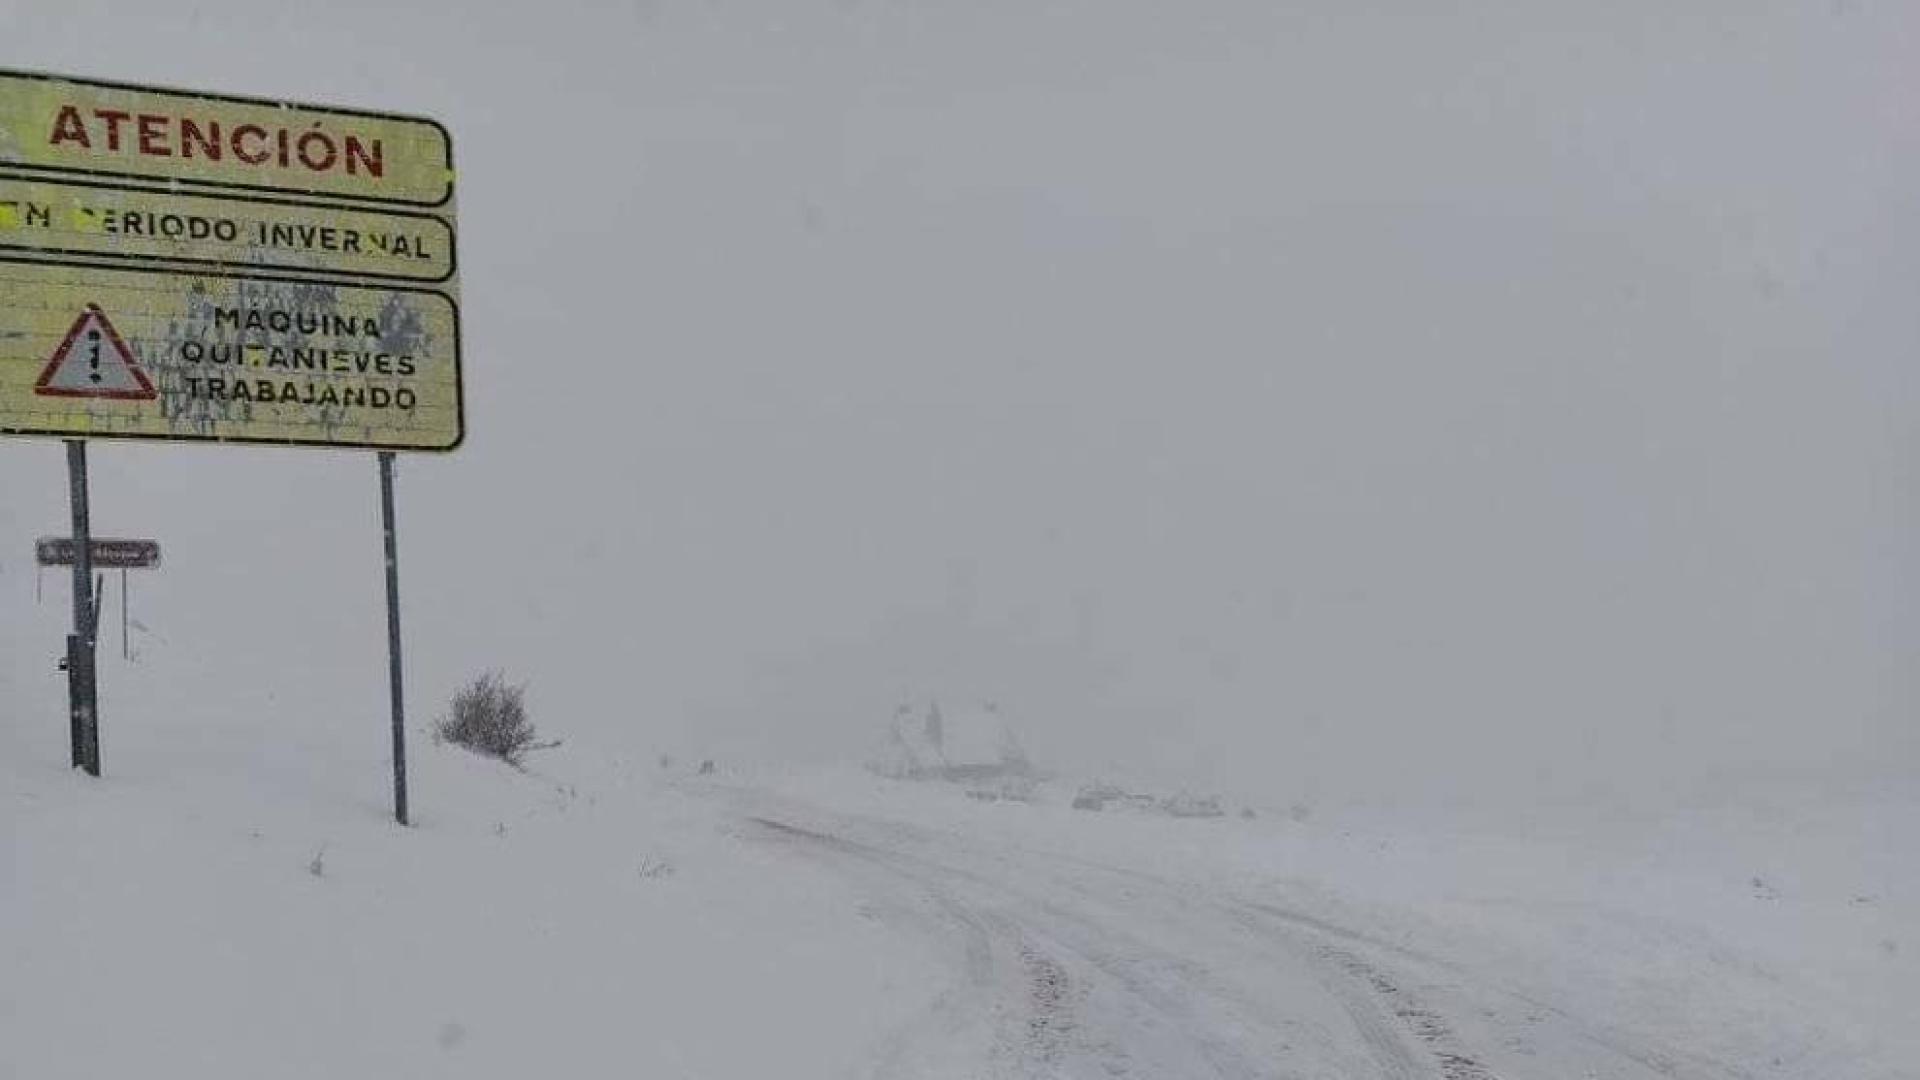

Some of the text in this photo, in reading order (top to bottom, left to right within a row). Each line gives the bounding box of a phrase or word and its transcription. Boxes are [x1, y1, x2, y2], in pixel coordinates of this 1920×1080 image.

[50, 105, 383, 178] ATENCIÓN
[0, 201, 431, 259] N ERIODO INVERNAL
[185, 377, 416, 409] TRABAJANDO
